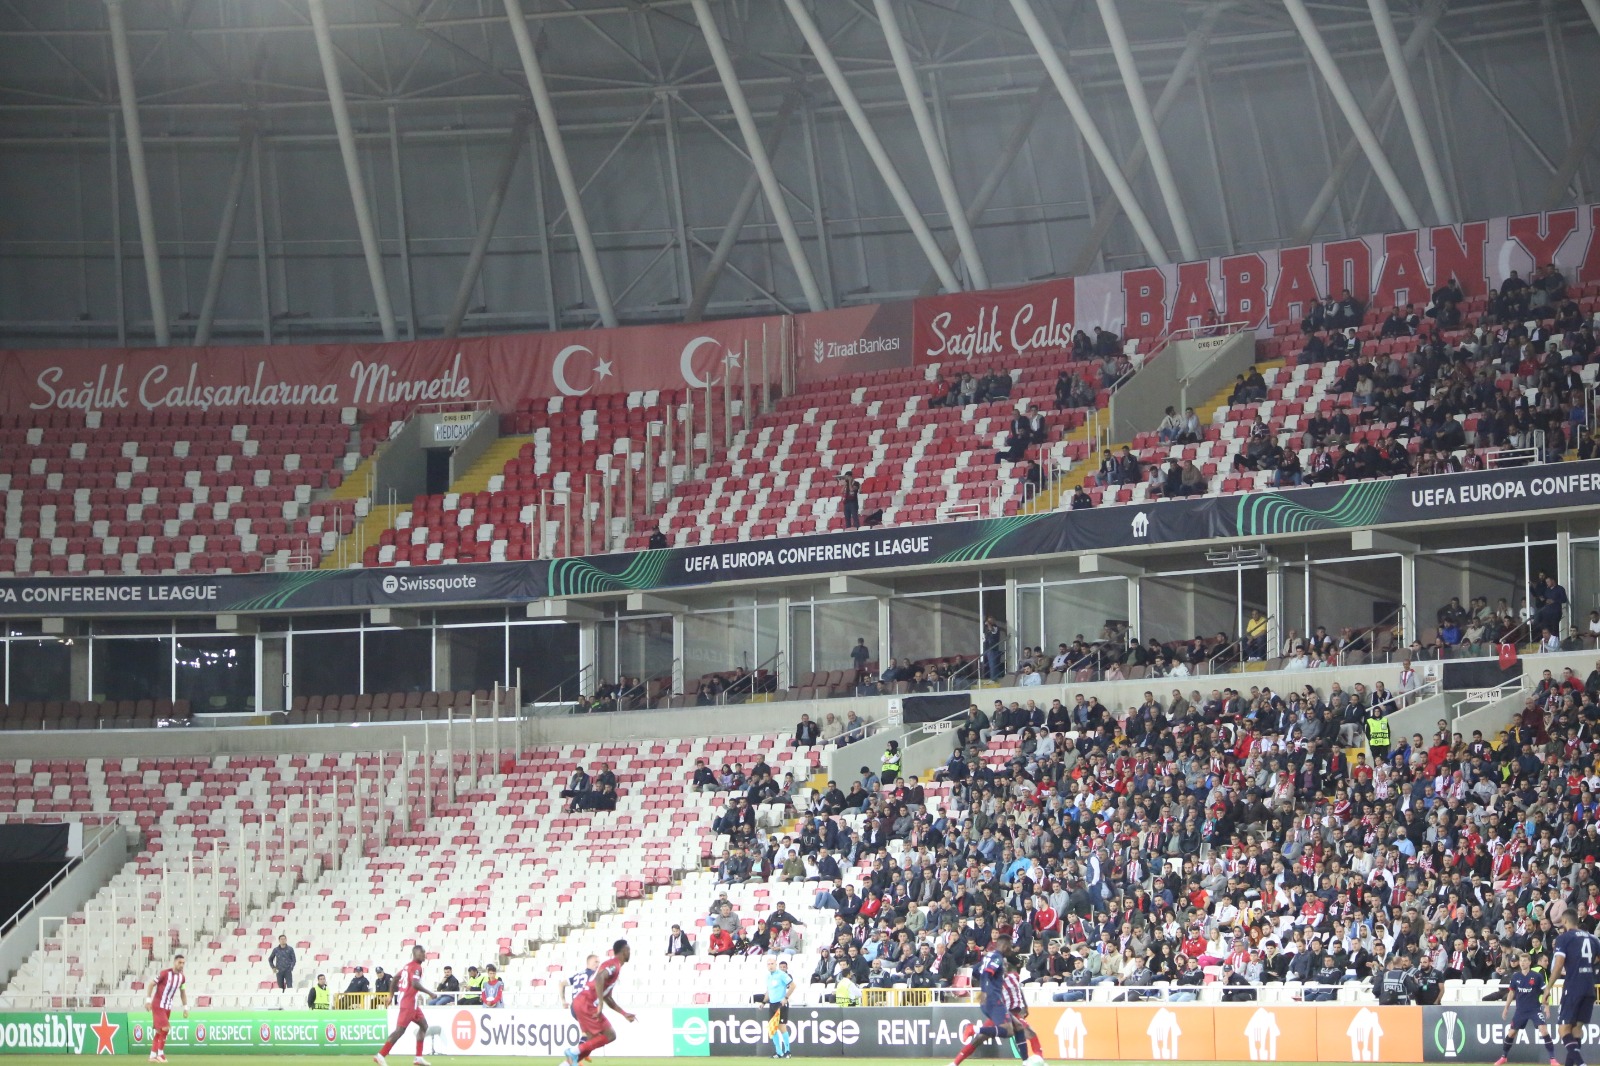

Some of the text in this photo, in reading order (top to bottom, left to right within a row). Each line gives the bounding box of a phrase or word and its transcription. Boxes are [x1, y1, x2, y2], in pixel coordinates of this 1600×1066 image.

[827, 336, 900, 359] Ziraat Bankası
[350, 352, 470, 404] Minnetle
[1412, 473, 1600, 507] UEFA EUROPA CONFER
[685, 536, 929, 573] UEFA EUROPA CONFERENCE LEAGUE
[22, 586, 141, 602] CONFERENCE
[149, 585, 217, 600] LEAGUE
[400, 575, 476, 593] Swissquote
[1581, 938, 1592, 964] 4
[0, 1014, 86, 1054] onsibly
[147, 1024, 387, 1041] RECT RESPECT RESPECT RESPECT
[481, 1014, 580, 1055] Swissquo
